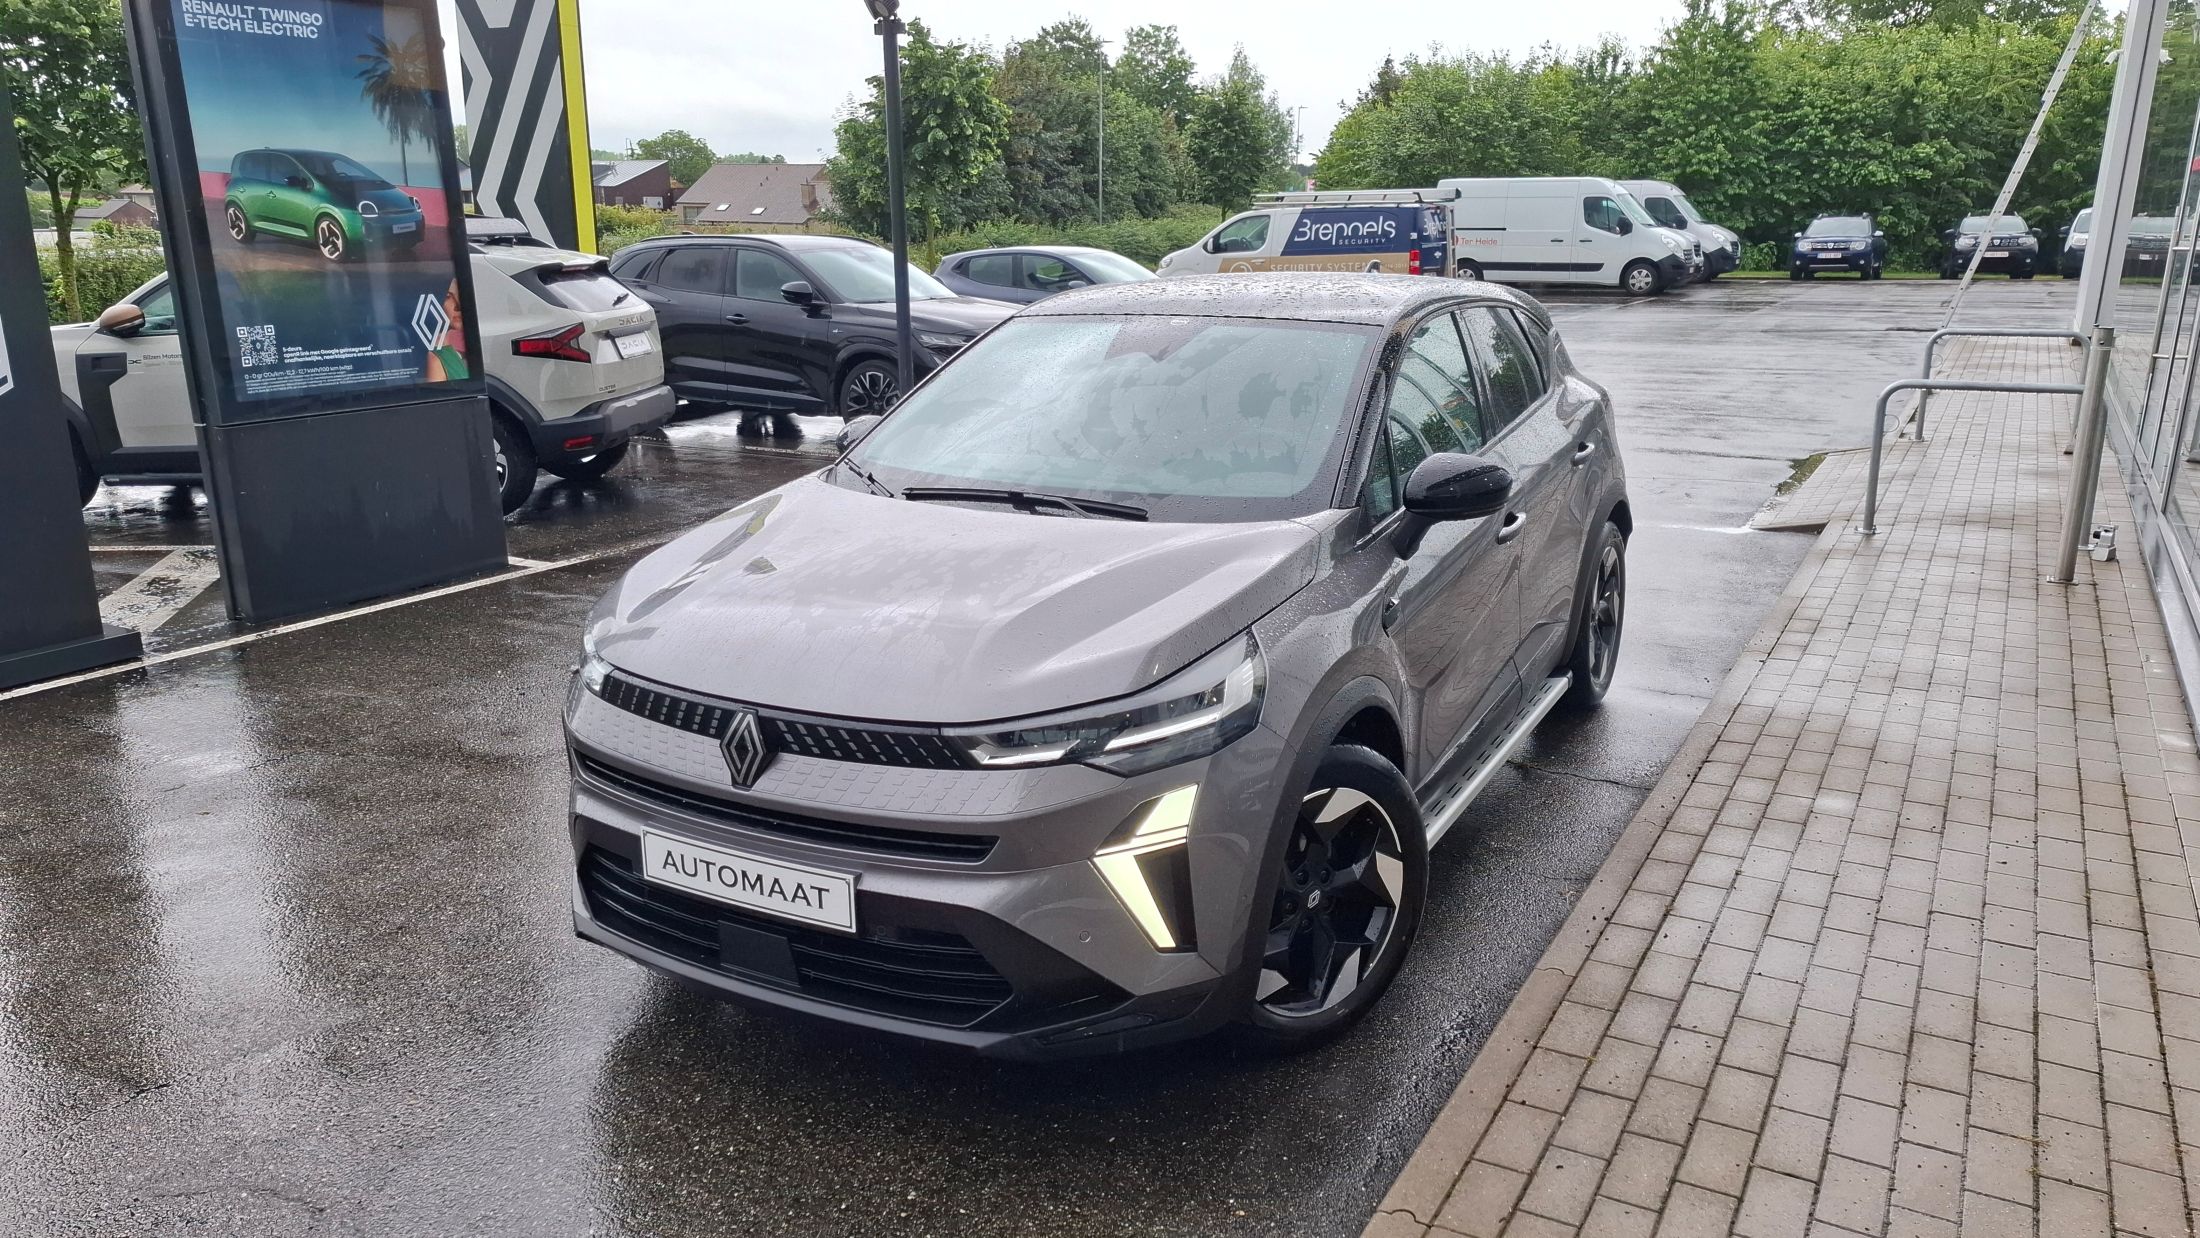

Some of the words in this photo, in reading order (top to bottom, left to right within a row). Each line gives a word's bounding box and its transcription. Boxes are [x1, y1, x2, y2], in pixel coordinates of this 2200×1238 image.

[182, 0, 255, 19] RENAULT
[258, 7, 323, 26] TWINGO
[184, 13, 242, 32] E-TECH
[244, 21, 319, 39] ELECTRIC
[1270, 263, 1323, 272] SECURITY
[619, 315, 645, 326] DACIA
[621, 338, 645, 349] DACIA
[662, 850, 830, 909] AUTOMAAT
